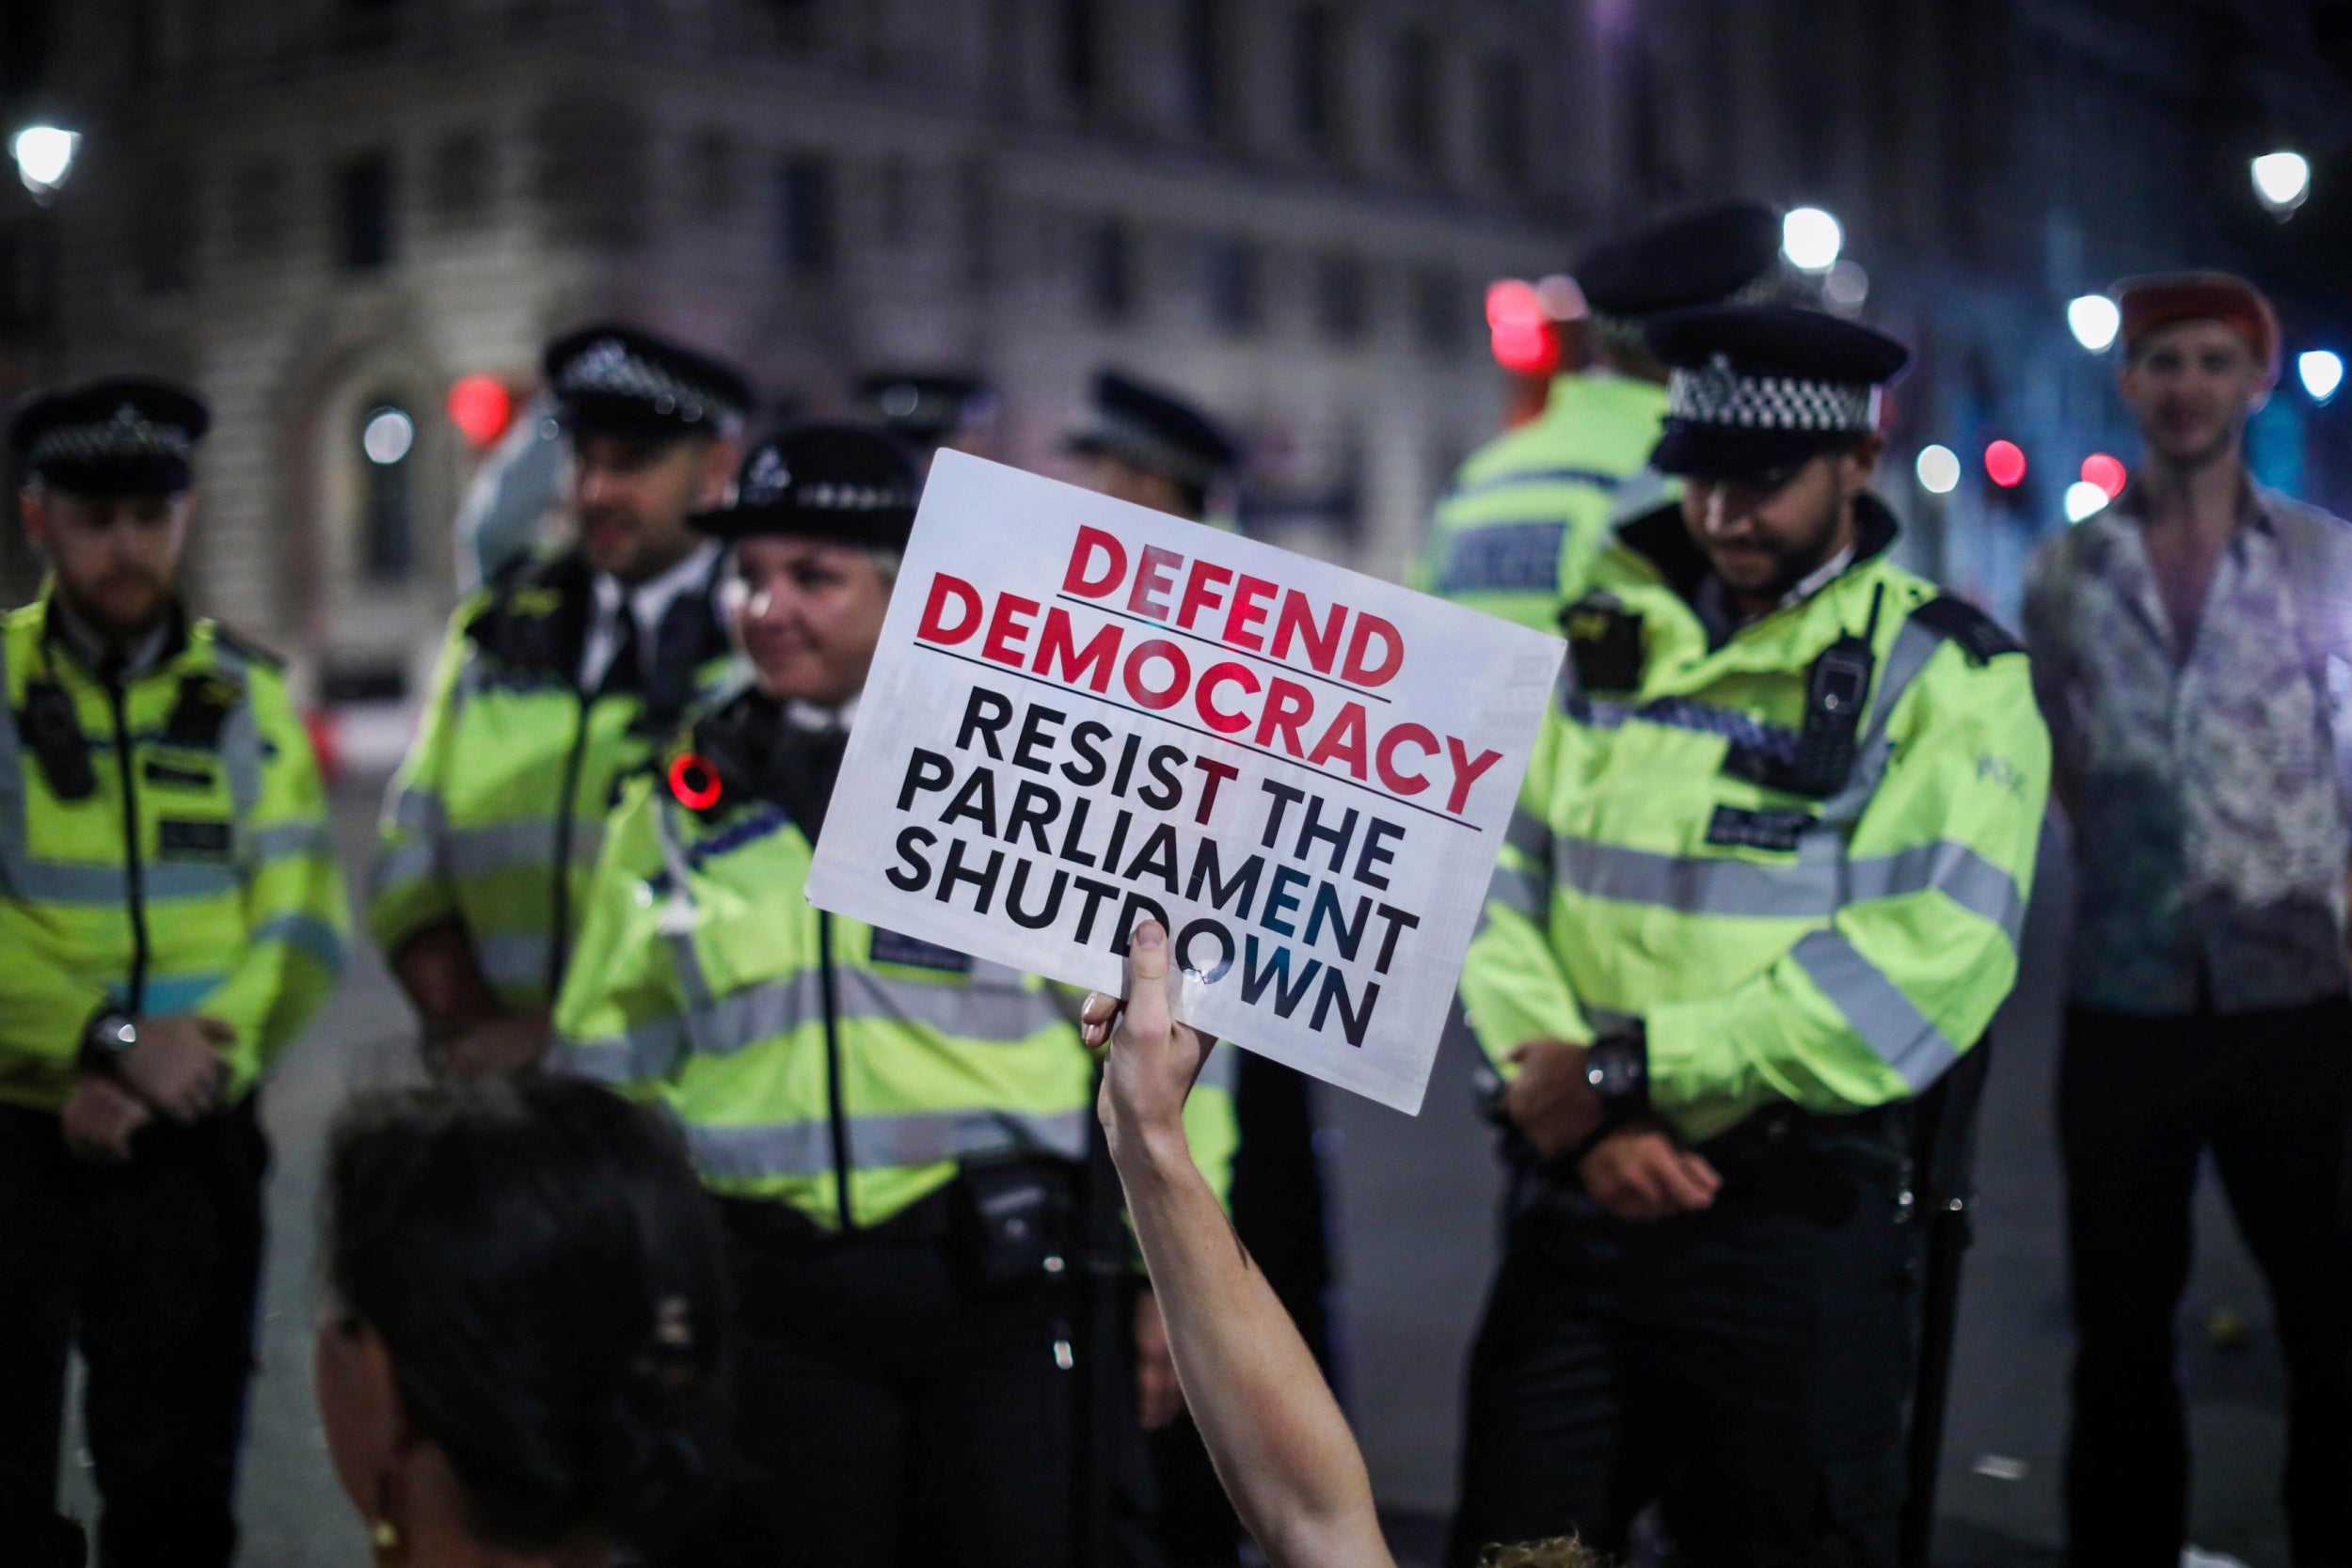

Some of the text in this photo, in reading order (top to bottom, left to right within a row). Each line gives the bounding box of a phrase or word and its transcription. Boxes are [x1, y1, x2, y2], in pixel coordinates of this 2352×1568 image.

[916, 571, 1504, 816] DEMOCRACY
[1061, 524, 1405, 688] DEFEND
[896, 747, 1421, 975] PARLIAMENT
[955, 686, 1406, 892] RESIST THE
[884, 825, 1381, 1049] SHUTDOWN
